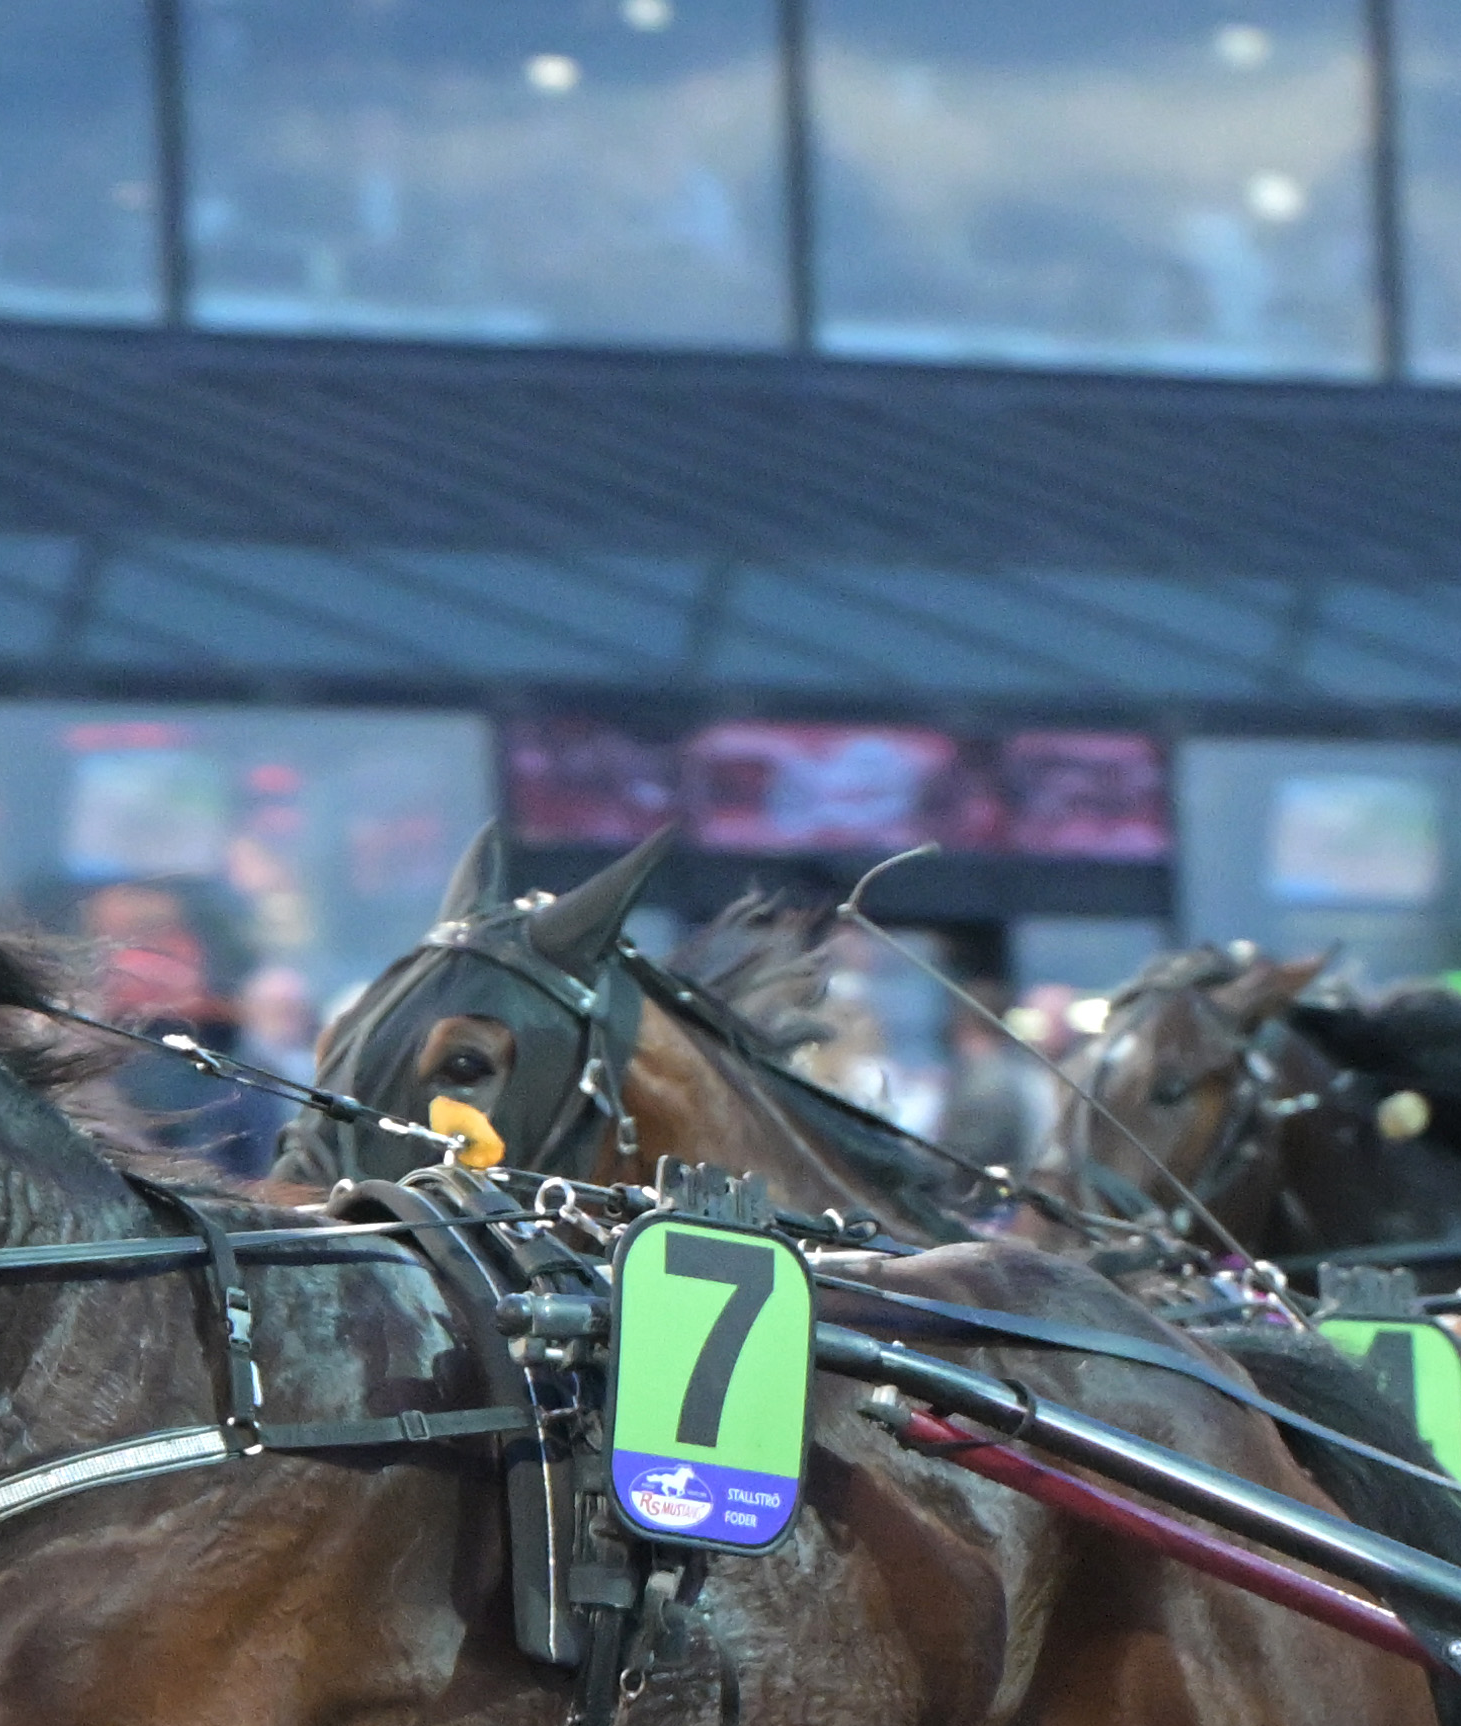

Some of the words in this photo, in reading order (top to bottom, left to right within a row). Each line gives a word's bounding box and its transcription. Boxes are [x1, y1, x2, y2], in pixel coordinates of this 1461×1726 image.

[665, 1231, 775, 1448] 7
[727, 1487, 781, 1508] STALLSTRÖ
[725, 1510, 758, 1528] FODER
